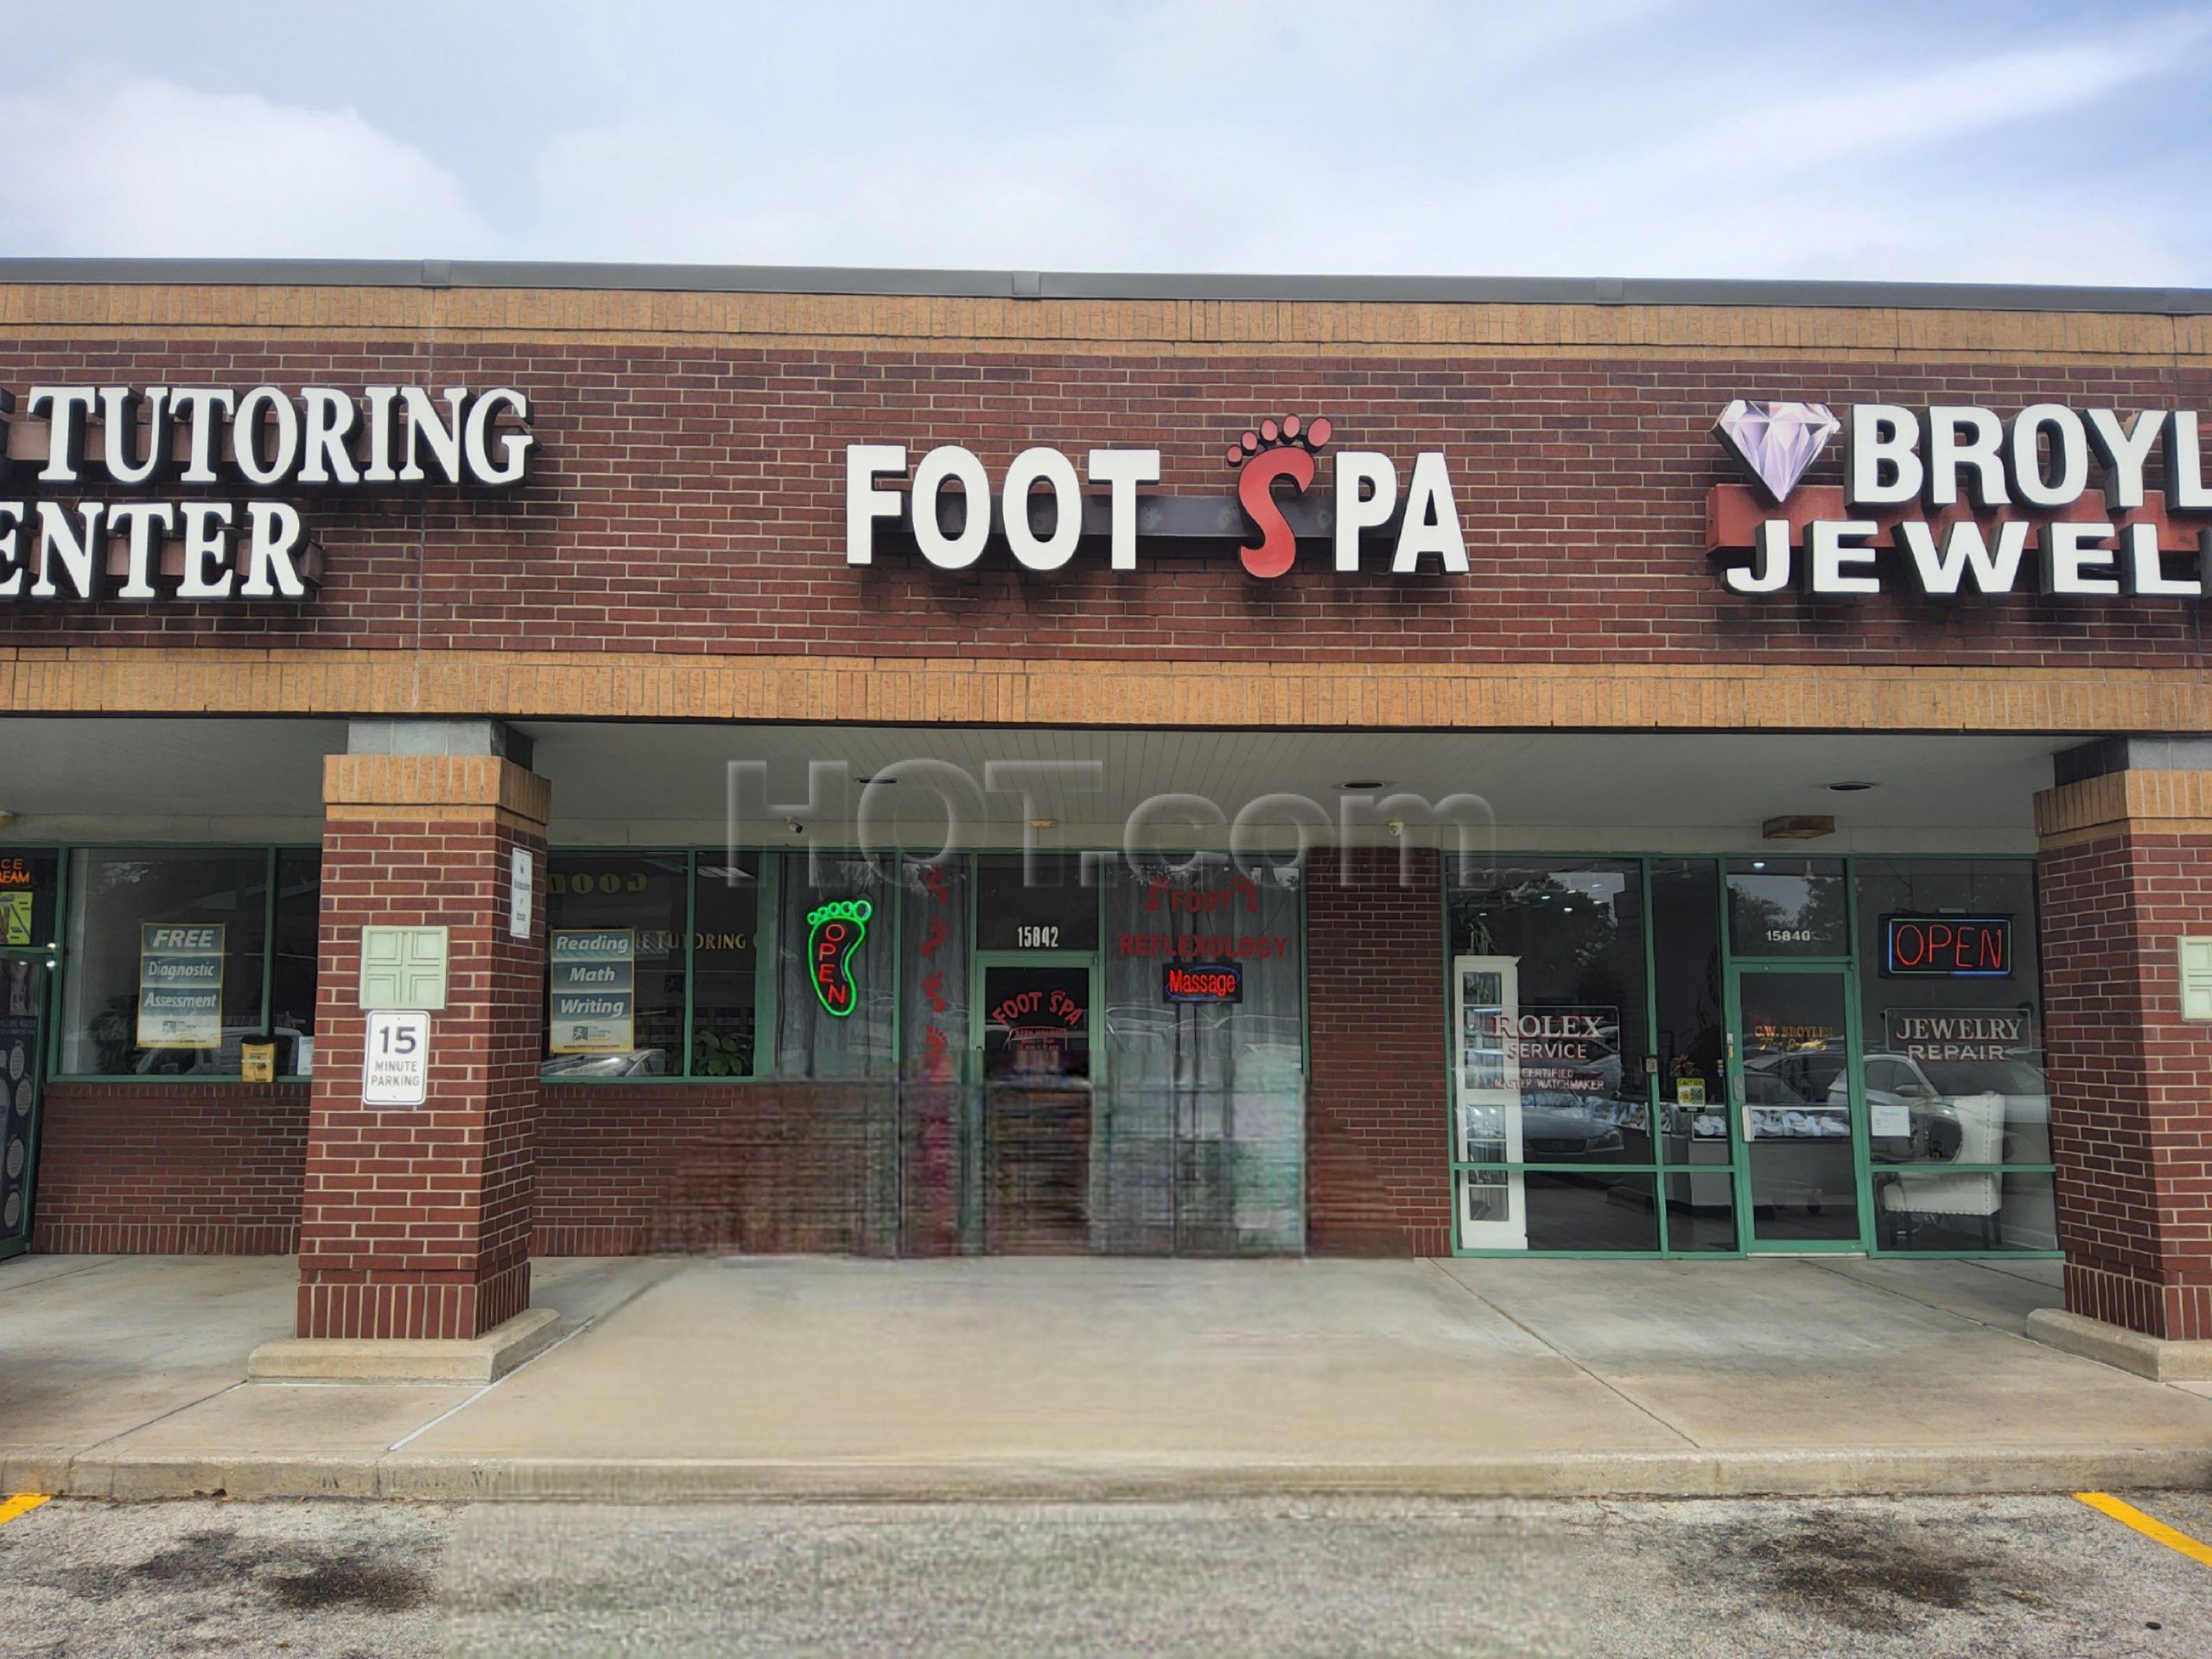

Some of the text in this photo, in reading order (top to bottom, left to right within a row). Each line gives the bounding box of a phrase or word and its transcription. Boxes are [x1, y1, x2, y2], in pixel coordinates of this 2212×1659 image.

[28, 385, 533, 484] TUTORING
[1853, 403, 2212, 507] BROYL
[846, 413, 1471, 579] FOOT SPA
[1726, 519, 2202, 594] JEWEL
[1171, 890, 1233, 913] FOOT
[153, 930, 214, 948] FREE
[556, 935, 628, 954] Reading
[657, 931, 747, 950] TUORING
[1119, 934, 1288, 959] REFLEXOLOGY
[1766, 930, 1811, 942] 15840
[1896, 925, 2002, 968] OPEN
[149, 960, 215, 981] Diagnostic
[569, 966, 615, 982] Math
[819, 923, 846, 1004] OPEN
[1169, 969, 1236, 998] Massage
[144, 991, 217, 1007] Assessment
[561, 998, 625, 1016] Writing
[992, 989, 1084, 1027] FOOT SPA
[1493, 1014, 1605, 1039] ROLEX
[1896, 1018, 2023, 1041] JEWELRY
[379, 1026, 416, 1054] 15
[1507, 1043, 1588, 1059] SERVICE
[1907, 1044, 2005, 1061] REPAIR
[375, 1060, 417, 1071] MINUTE
[1522, 1067, 1573, 1079] CERTIFIED
[372, 1075, 420, 1086] PARKING
[1536, 1079, 1605, 1090] WATCHMAKER
